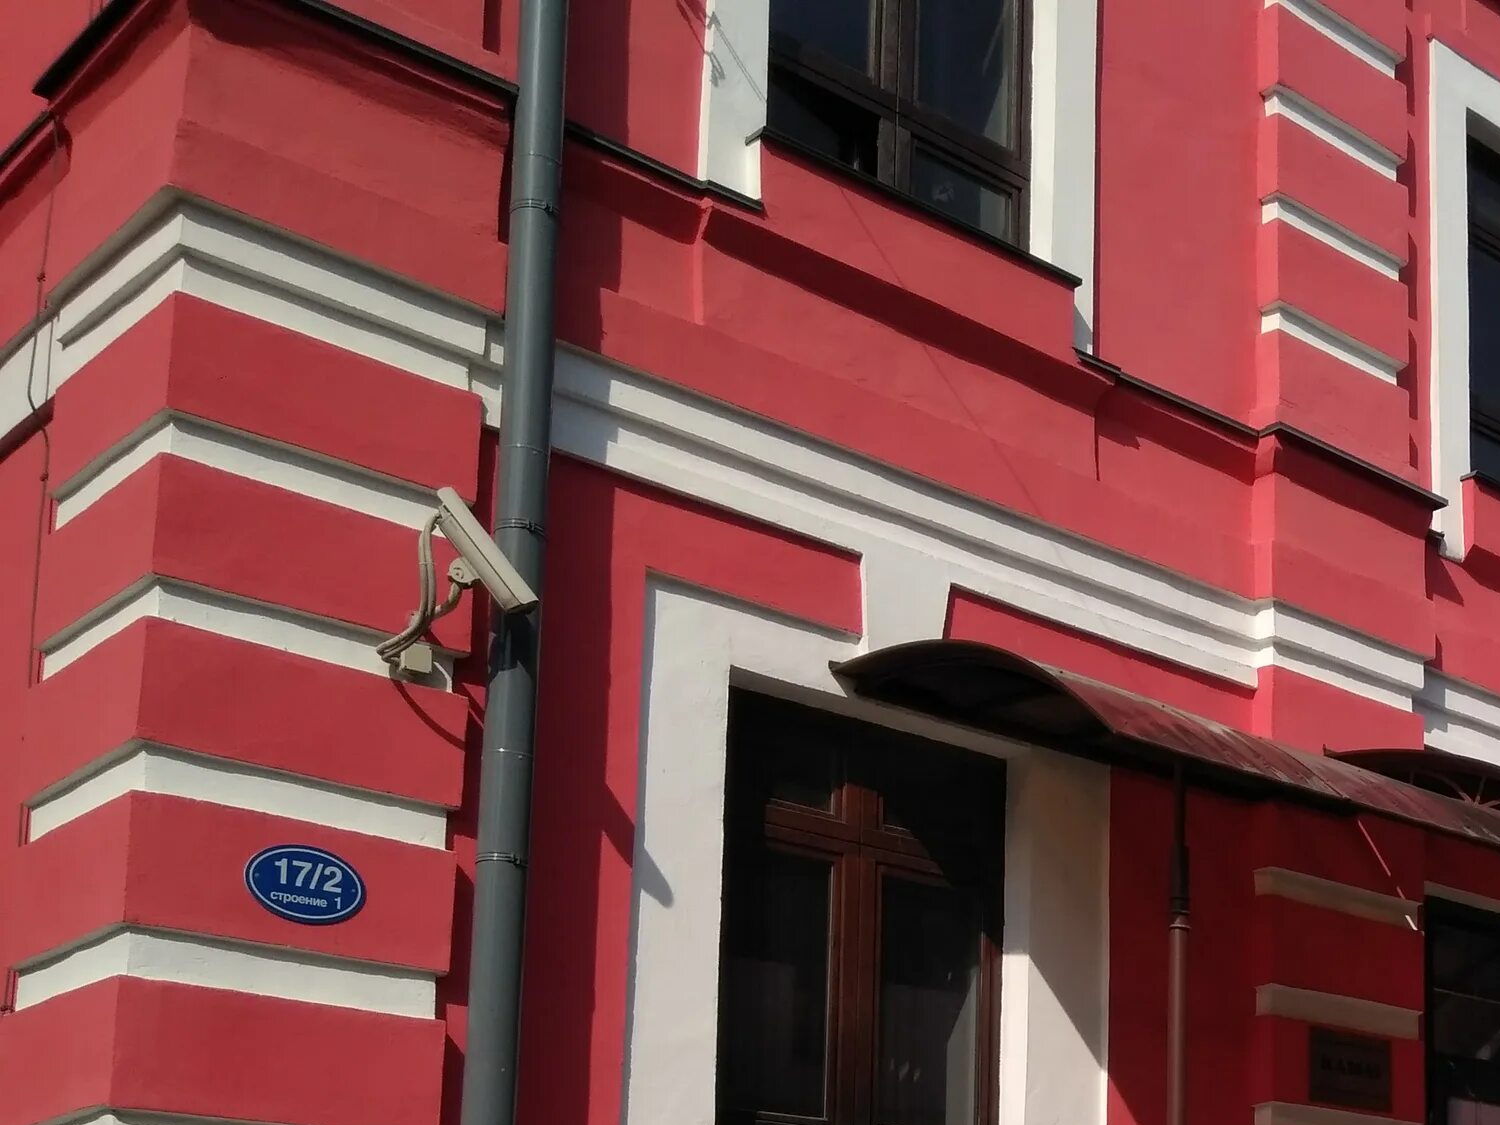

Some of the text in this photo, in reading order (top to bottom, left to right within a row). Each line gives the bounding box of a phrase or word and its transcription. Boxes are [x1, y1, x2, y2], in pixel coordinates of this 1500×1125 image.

[274, 858, 343, 893] 17/2
[270, 890, 342, 910] строение 1
